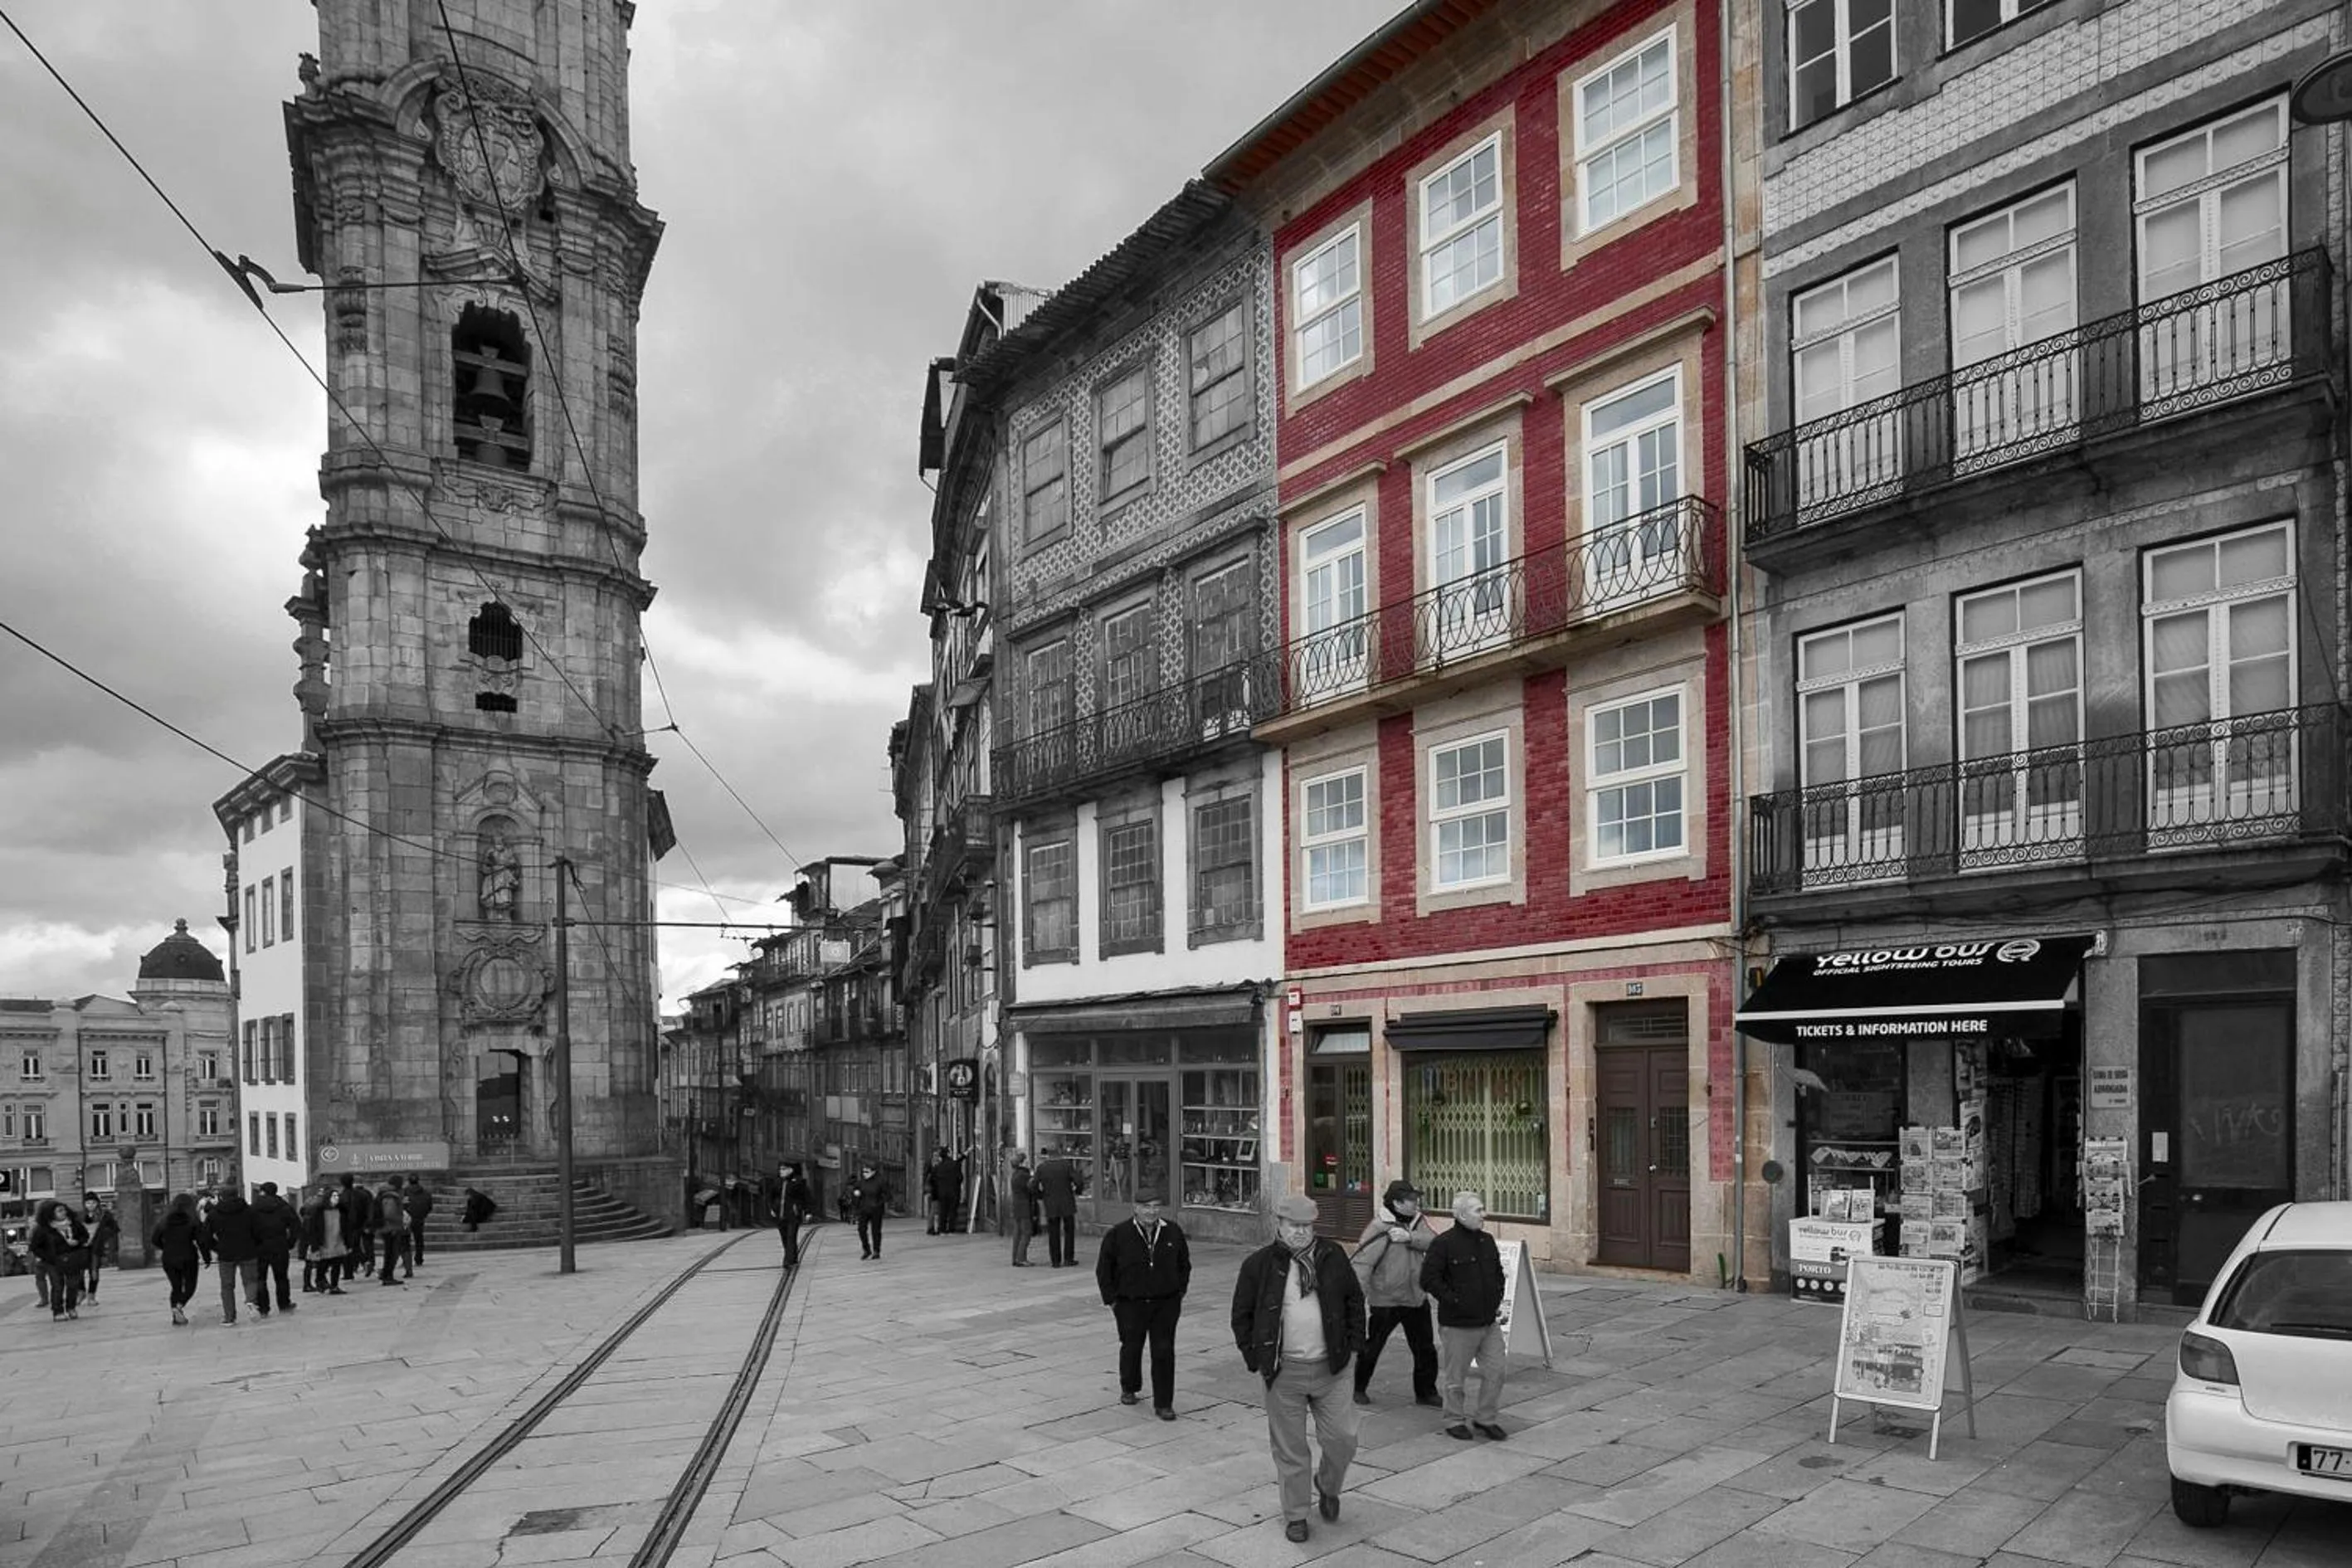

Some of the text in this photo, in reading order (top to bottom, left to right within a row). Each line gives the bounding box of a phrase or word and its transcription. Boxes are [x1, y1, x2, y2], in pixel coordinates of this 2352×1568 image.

[1813, 957, 1983, 976] OFFICIAL SIGHTSEEING TOURS
[1796, 1020, 1987, 1036] TICKETS & INFORMATION HERE
